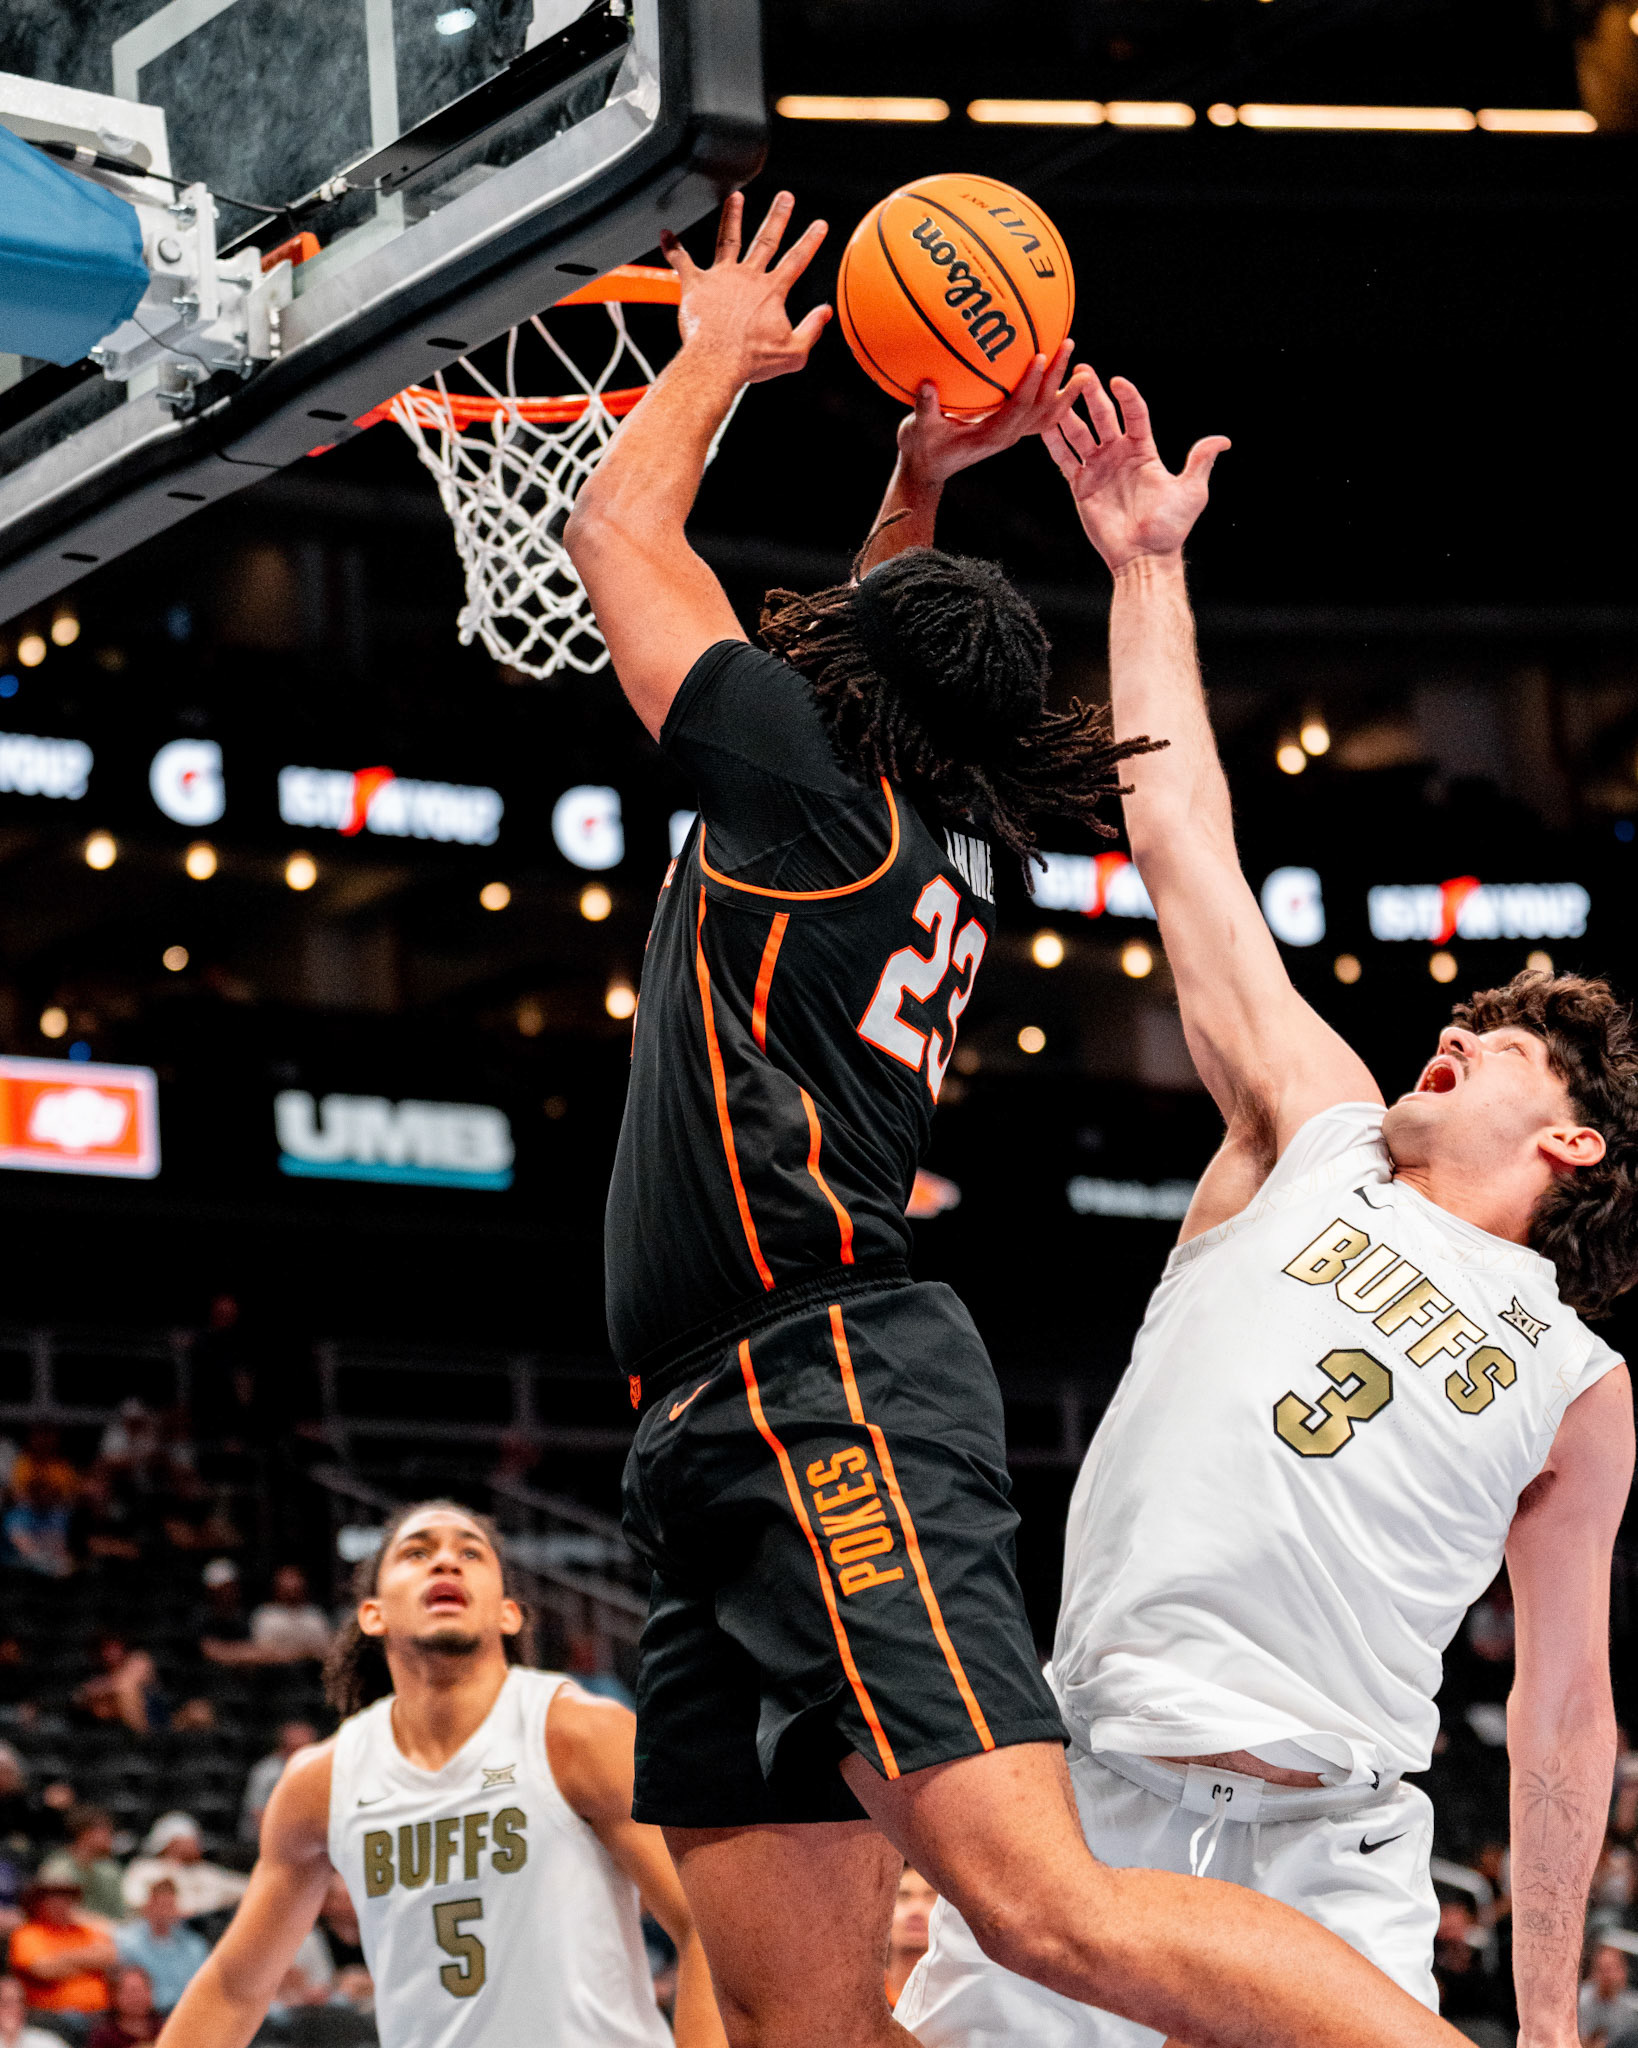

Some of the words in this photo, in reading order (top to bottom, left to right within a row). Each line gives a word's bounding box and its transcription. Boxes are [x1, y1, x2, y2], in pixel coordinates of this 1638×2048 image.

[912, 217, 1017, 363] Wilson
[149, 738, 226, 826] G
[551, 785, 625, 870] G
[1262, 867, 1326, 946] G
[857, 874, 988, 1104] 23
[274, 1090, 515, 1174] UMB
[1281, 1217, 1517, 1415] BUFFS
[1273, 1348, 1393, 1458] 3
[806, 1445, 905, 1597] POKES
[363, 1807, 528, 1897] BUFFS
[433, 1898, 486, 1998] 5
